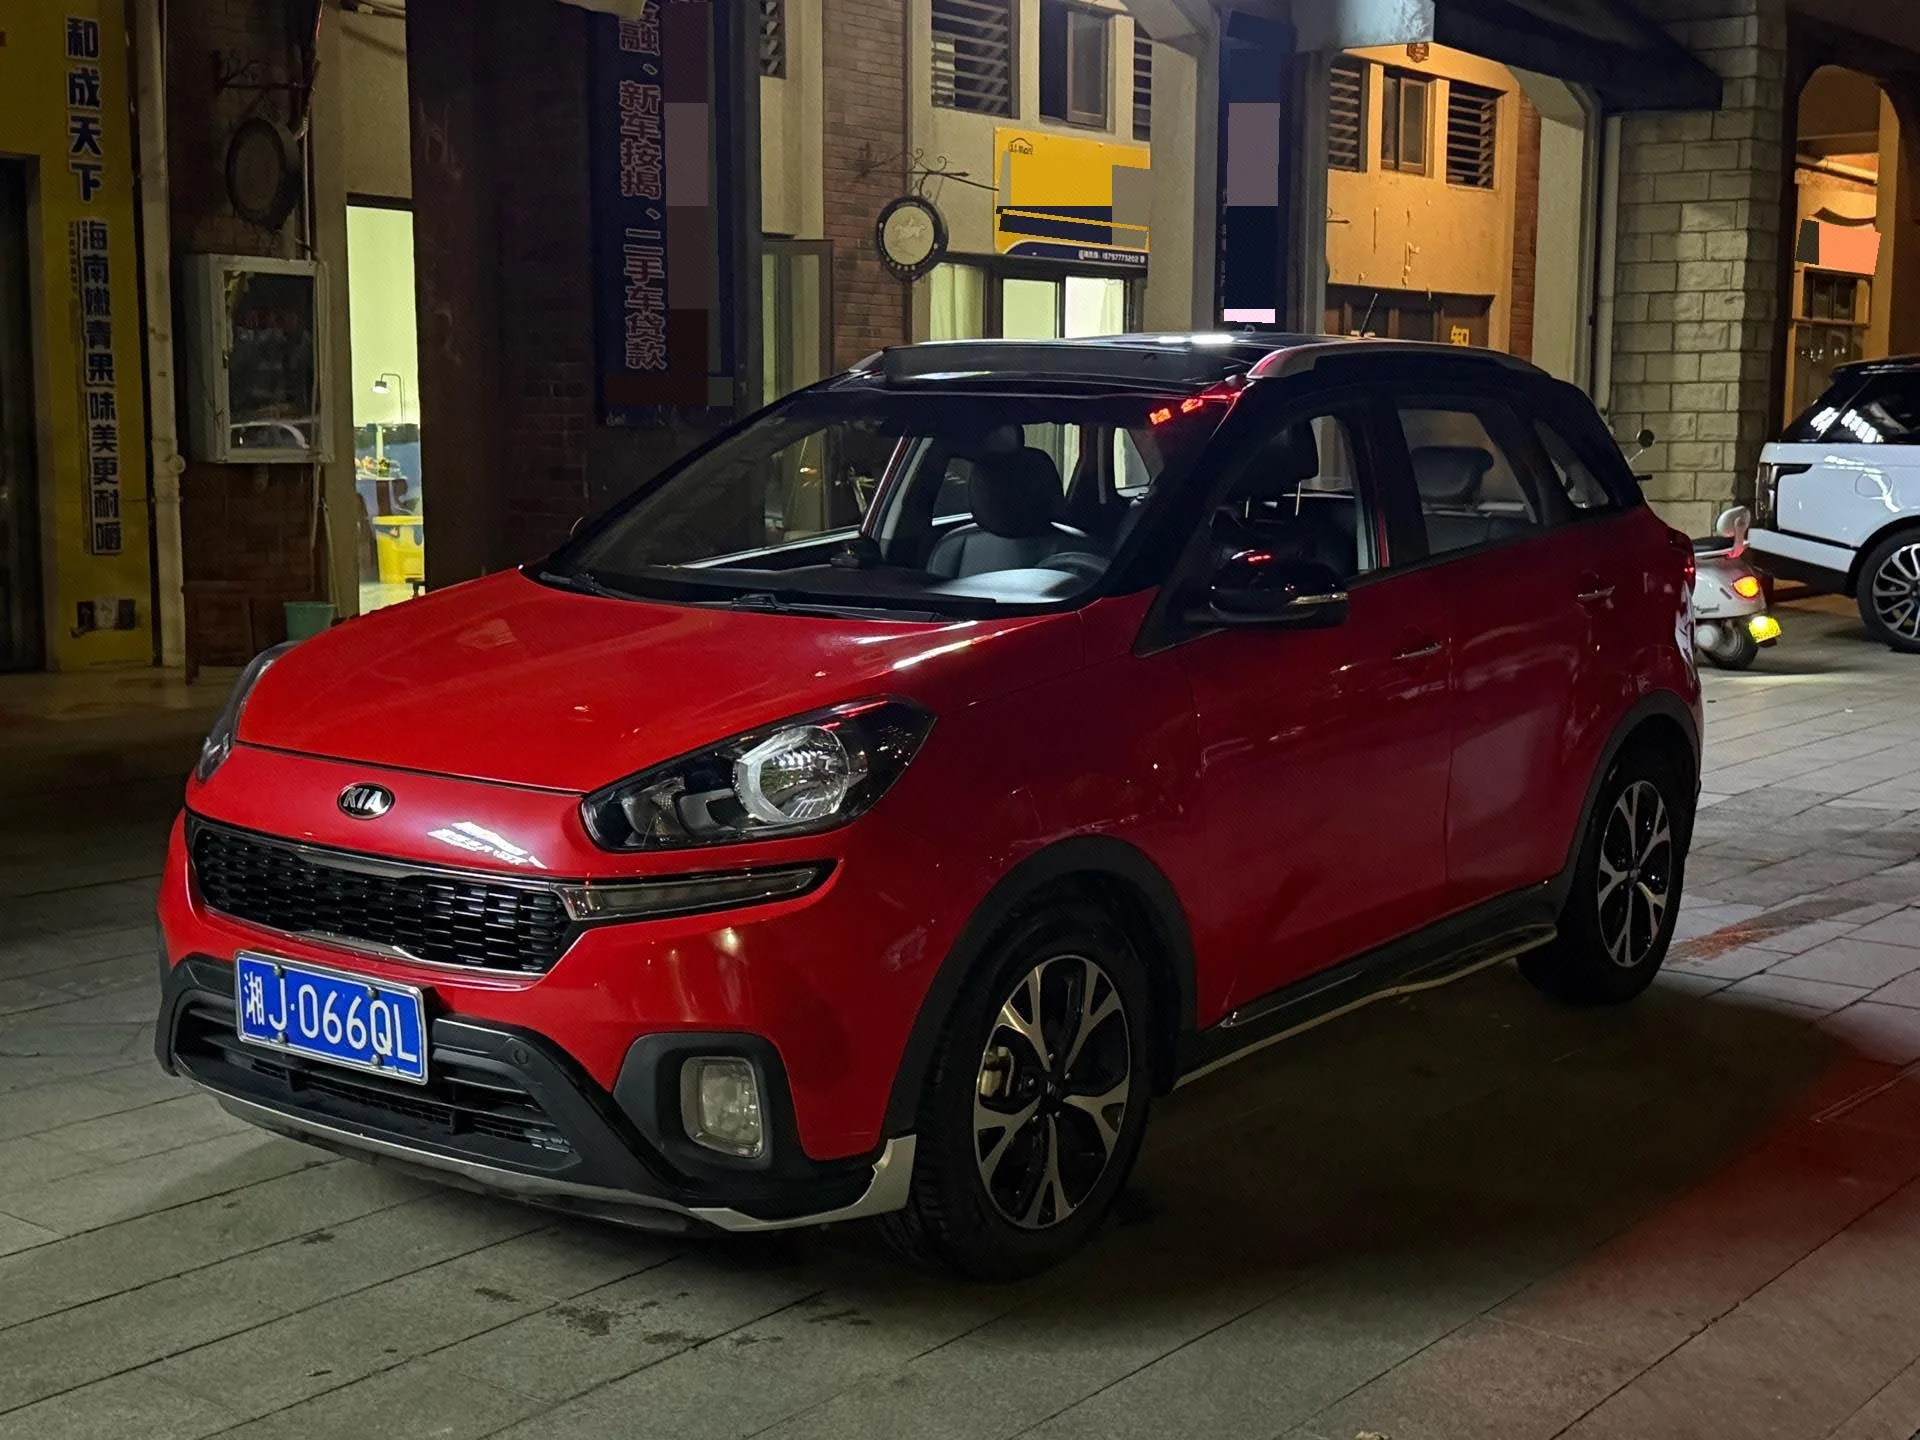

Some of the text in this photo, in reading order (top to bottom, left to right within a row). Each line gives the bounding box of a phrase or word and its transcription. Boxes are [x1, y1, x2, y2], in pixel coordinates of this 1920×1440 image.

[67, 16, 102, 203] 和成天下
[343, 787, 382, 810] KIA
